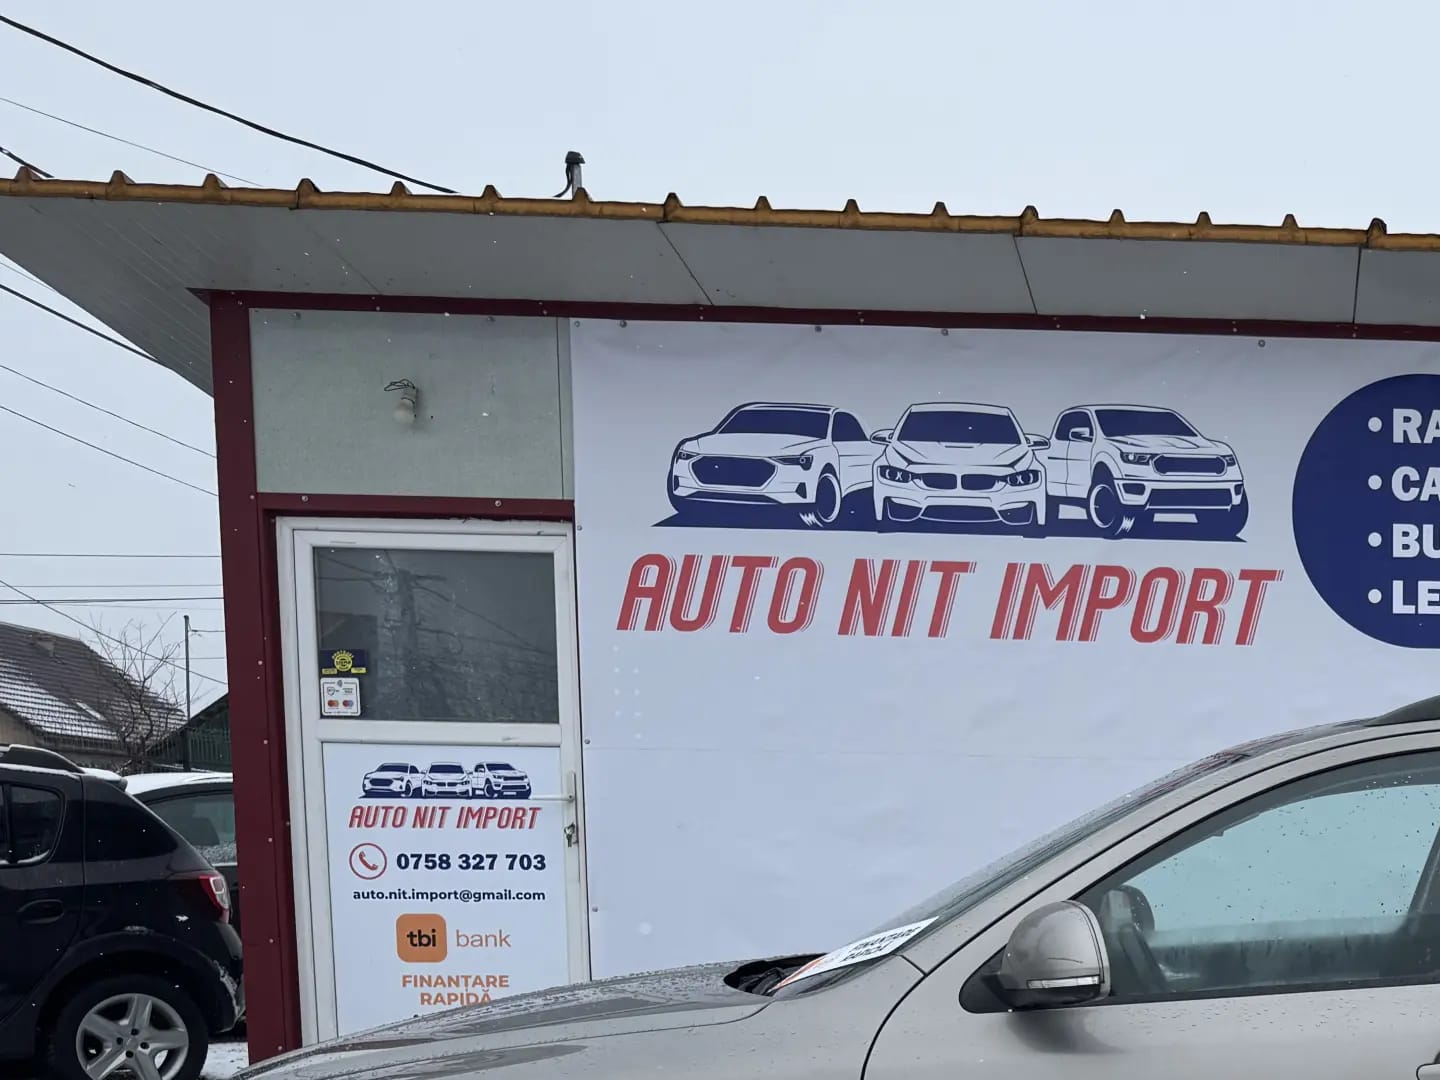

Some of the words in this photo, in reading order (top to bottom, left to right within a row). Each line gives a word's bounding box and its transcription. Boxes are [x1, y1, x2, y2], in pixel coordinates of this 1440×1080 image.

[616, 553, 824, 635] AUTO
[838, 558, 976, 639] NIT
[990, 563, 1283, 647] IMPORT
[349, 805, 408, 829] AUTO
[412, 806, 450, 829] NIT
[457, 806, 541, 830] IMPORT
[396, 853, 452, 871] 0758
[458, 853, 498, 871] 327
[505, 853, 546, 871] 703
[352, 887, 546, 903] auto.nit.import@gmail.com
[406, 928, 437, 948] tbi
[455, 929, 511, 948] bank
